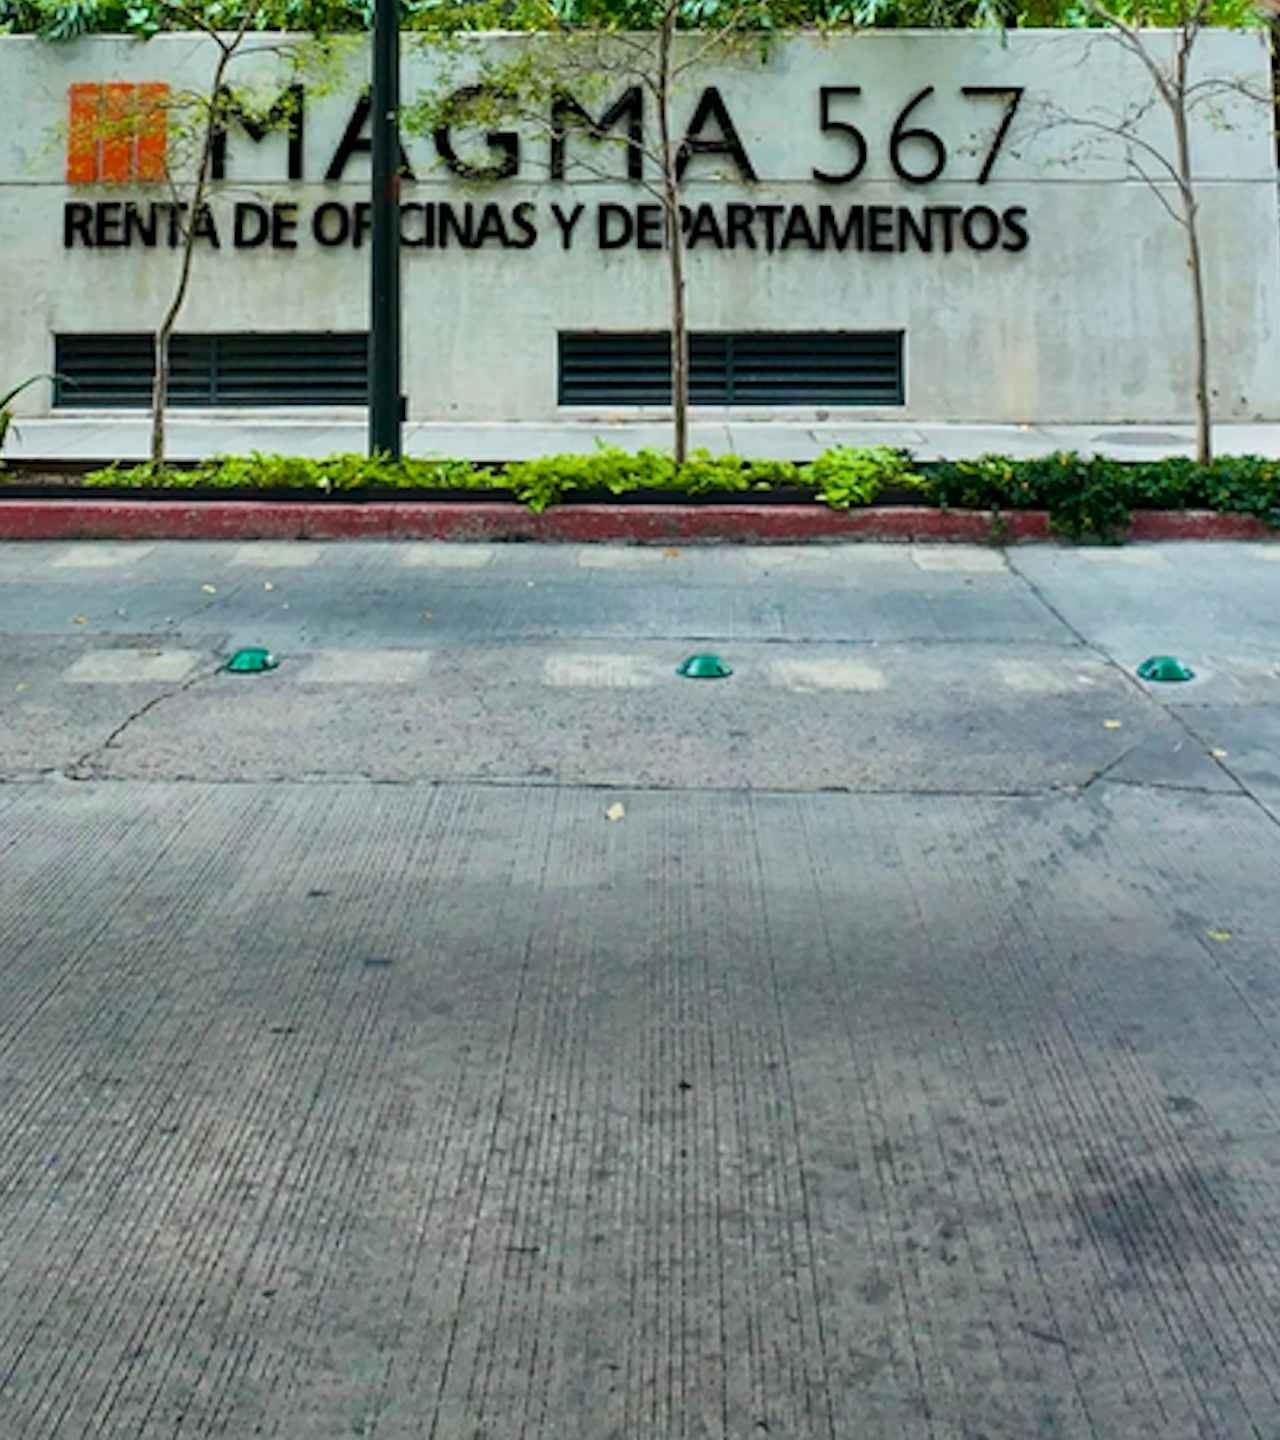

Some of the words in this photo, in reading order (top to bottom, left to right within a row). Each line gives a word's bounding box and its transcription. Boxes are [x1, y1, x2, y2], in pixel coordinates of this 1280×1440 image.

[210, 83, 759, 181] MAGMA
[813, 86, 1025, 185] 567
[64, 201, 220, 249] RENTA
[233, 202, 298, 249] DE
[312, 202, 538, 250] OFCINAS
[550, 203, 585, 249] Y
